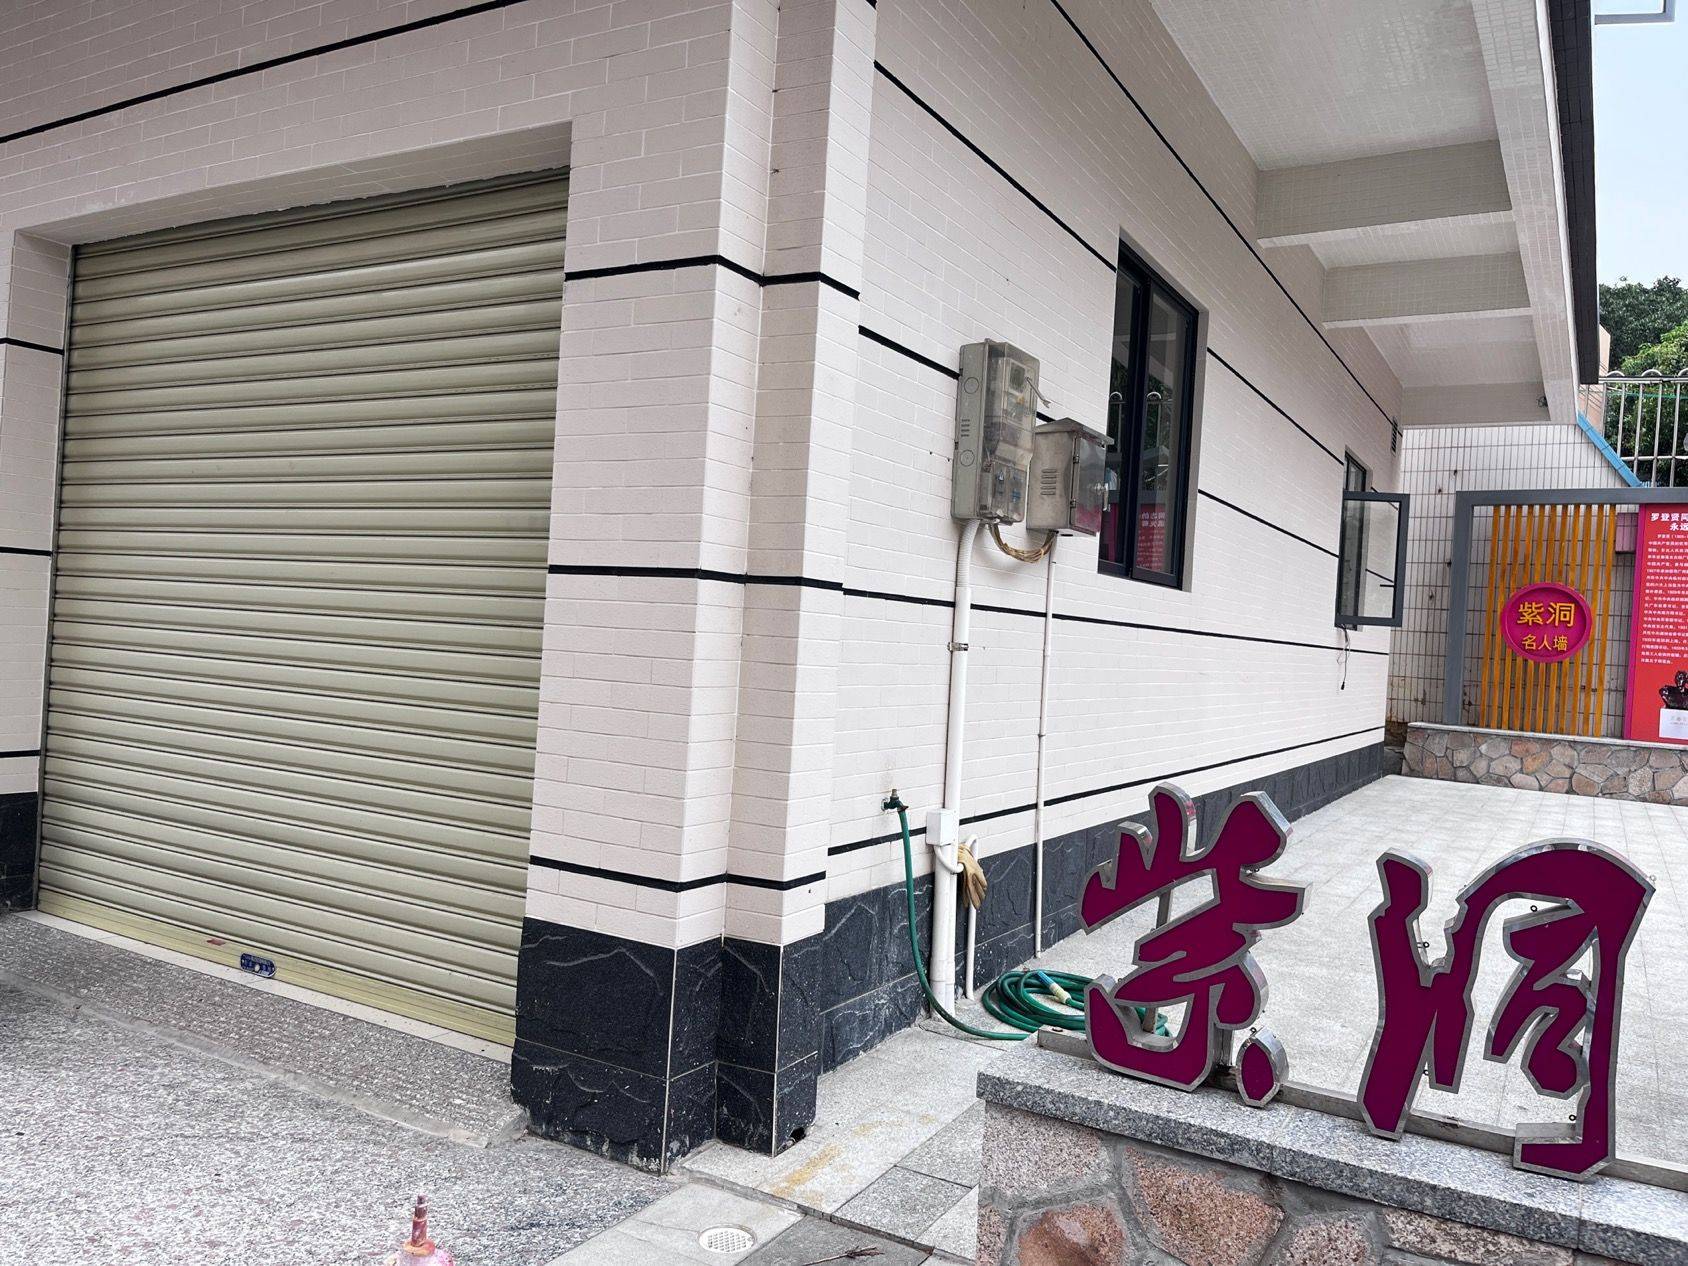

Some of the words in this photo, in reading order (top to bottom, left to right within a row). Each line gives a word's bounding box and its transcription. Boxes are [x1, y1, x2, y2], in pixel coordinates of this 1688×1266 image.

[1517, 601, 1575, 626] 紫洞
[1522, 634, 1568, 651] 名人墙
[1080, 781, 1656, 1181] 紫洞
